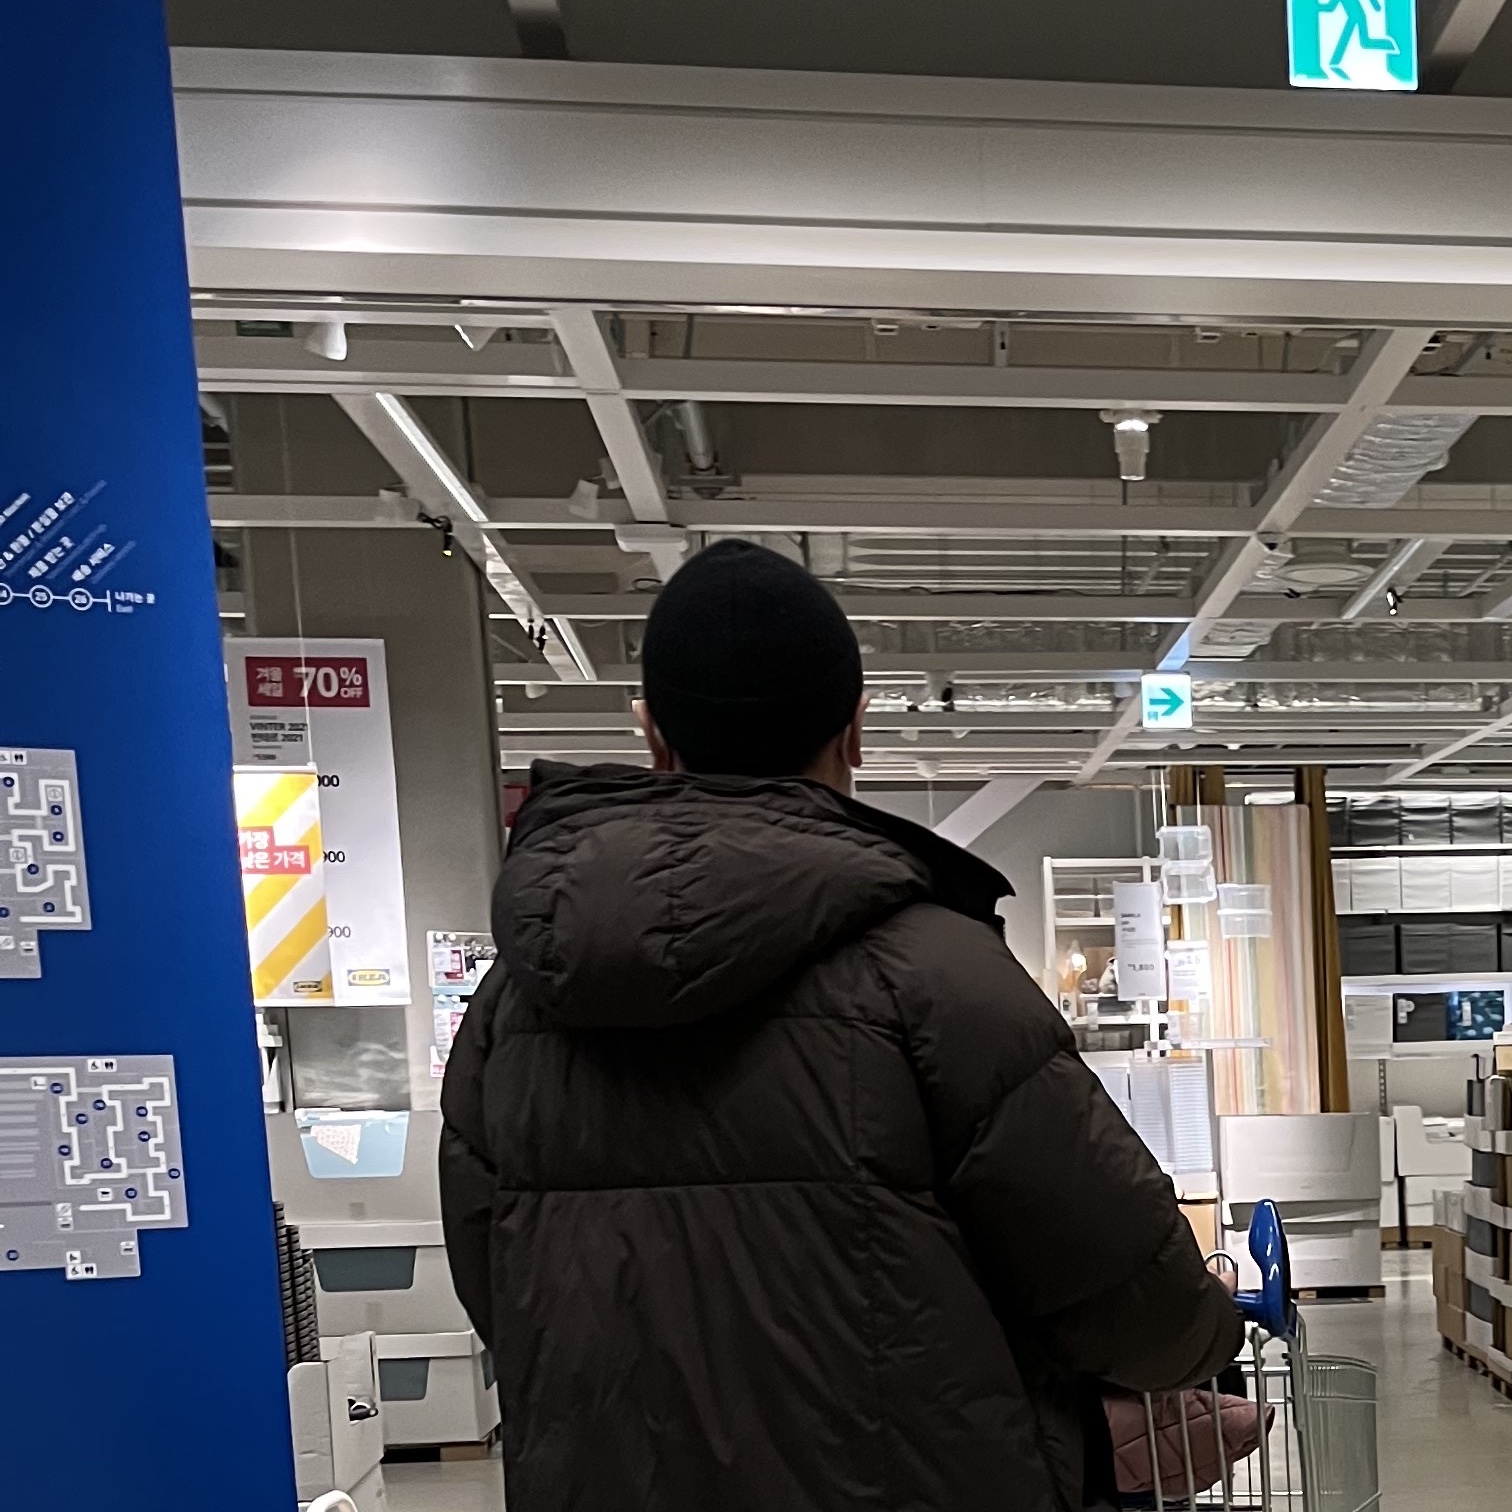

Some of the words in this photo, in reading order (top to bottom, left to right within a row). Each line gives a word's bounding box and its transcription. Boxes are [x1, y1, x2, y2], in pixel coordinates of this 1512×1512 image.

[340, 688, 363, 698] OFF
[281, 734, 303, 742] 2021
[273, 850, 305, 869] 가격
